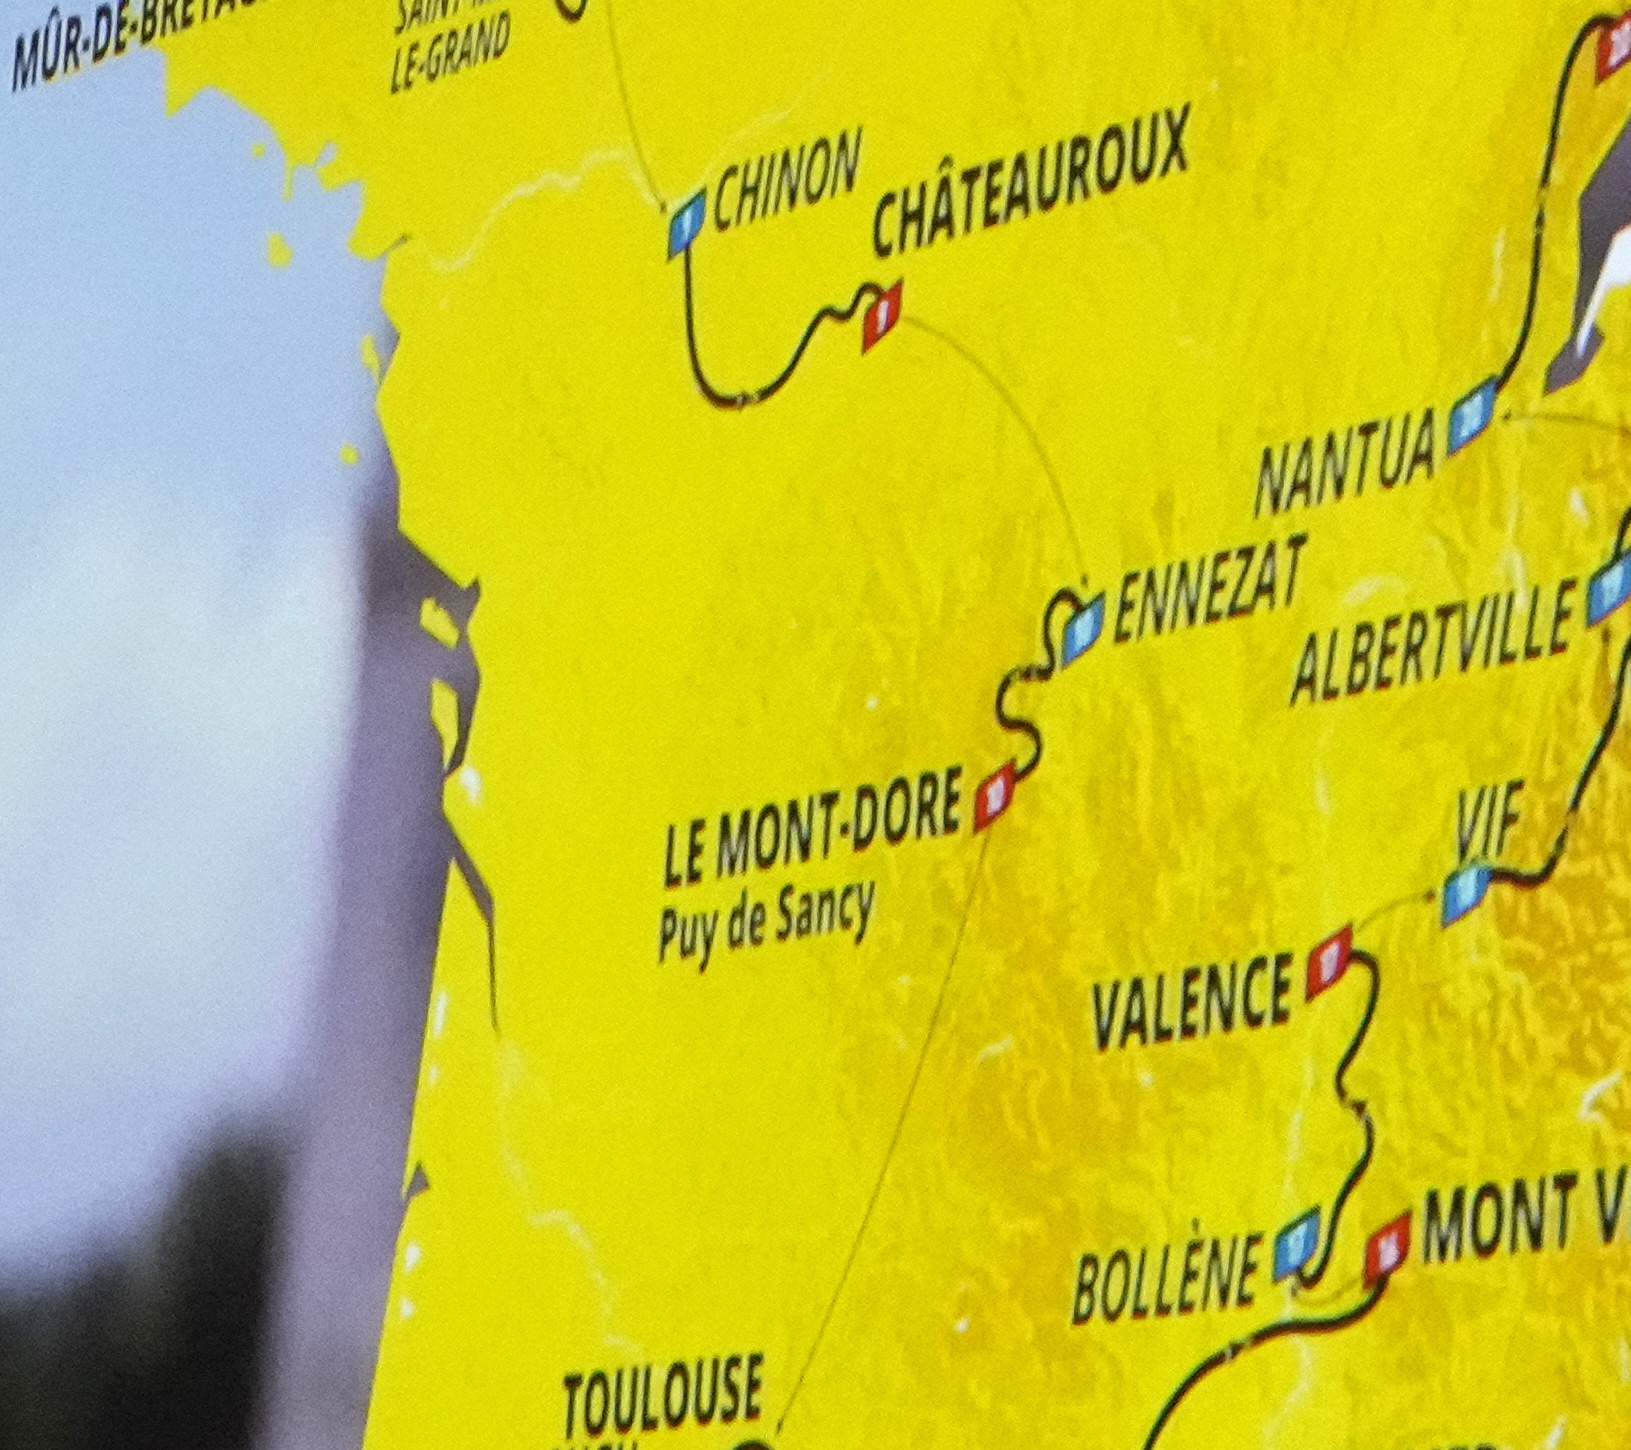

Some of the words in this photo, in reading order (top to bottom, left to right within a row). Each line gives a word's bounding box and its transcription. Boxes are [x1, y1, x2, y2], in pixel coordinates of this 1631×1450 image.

[390, 10, 512, 95] LE-GRAND
[713, 125, 864, 233] CHINON
[872, 100, 1193, 259] CHÂTEAUROUX
[1252, 406, 1438, 521] NANTUA
[1112, 533, 1310, 645] ENNEZAT
[1288, 578, 1579, 708] ALBERTVILLE
[662, 817, 704, 891] LE
[715, 765, 965, 880] MONT-DORE
[1457, 779, 1526, 860] VIF
[658, 904, 719, 974] Puy
[726, 889, 767, 951] de
[775, 878, 877, 945] Sancy
[1091, 951, 1296, 1052] VALENCE
[1421, 1171, 1579, 1266] MONT
[1072, 1219, 1265, 1326] BOLLÈNE
[563, 1352, 765, 1439] TOULOUSE
